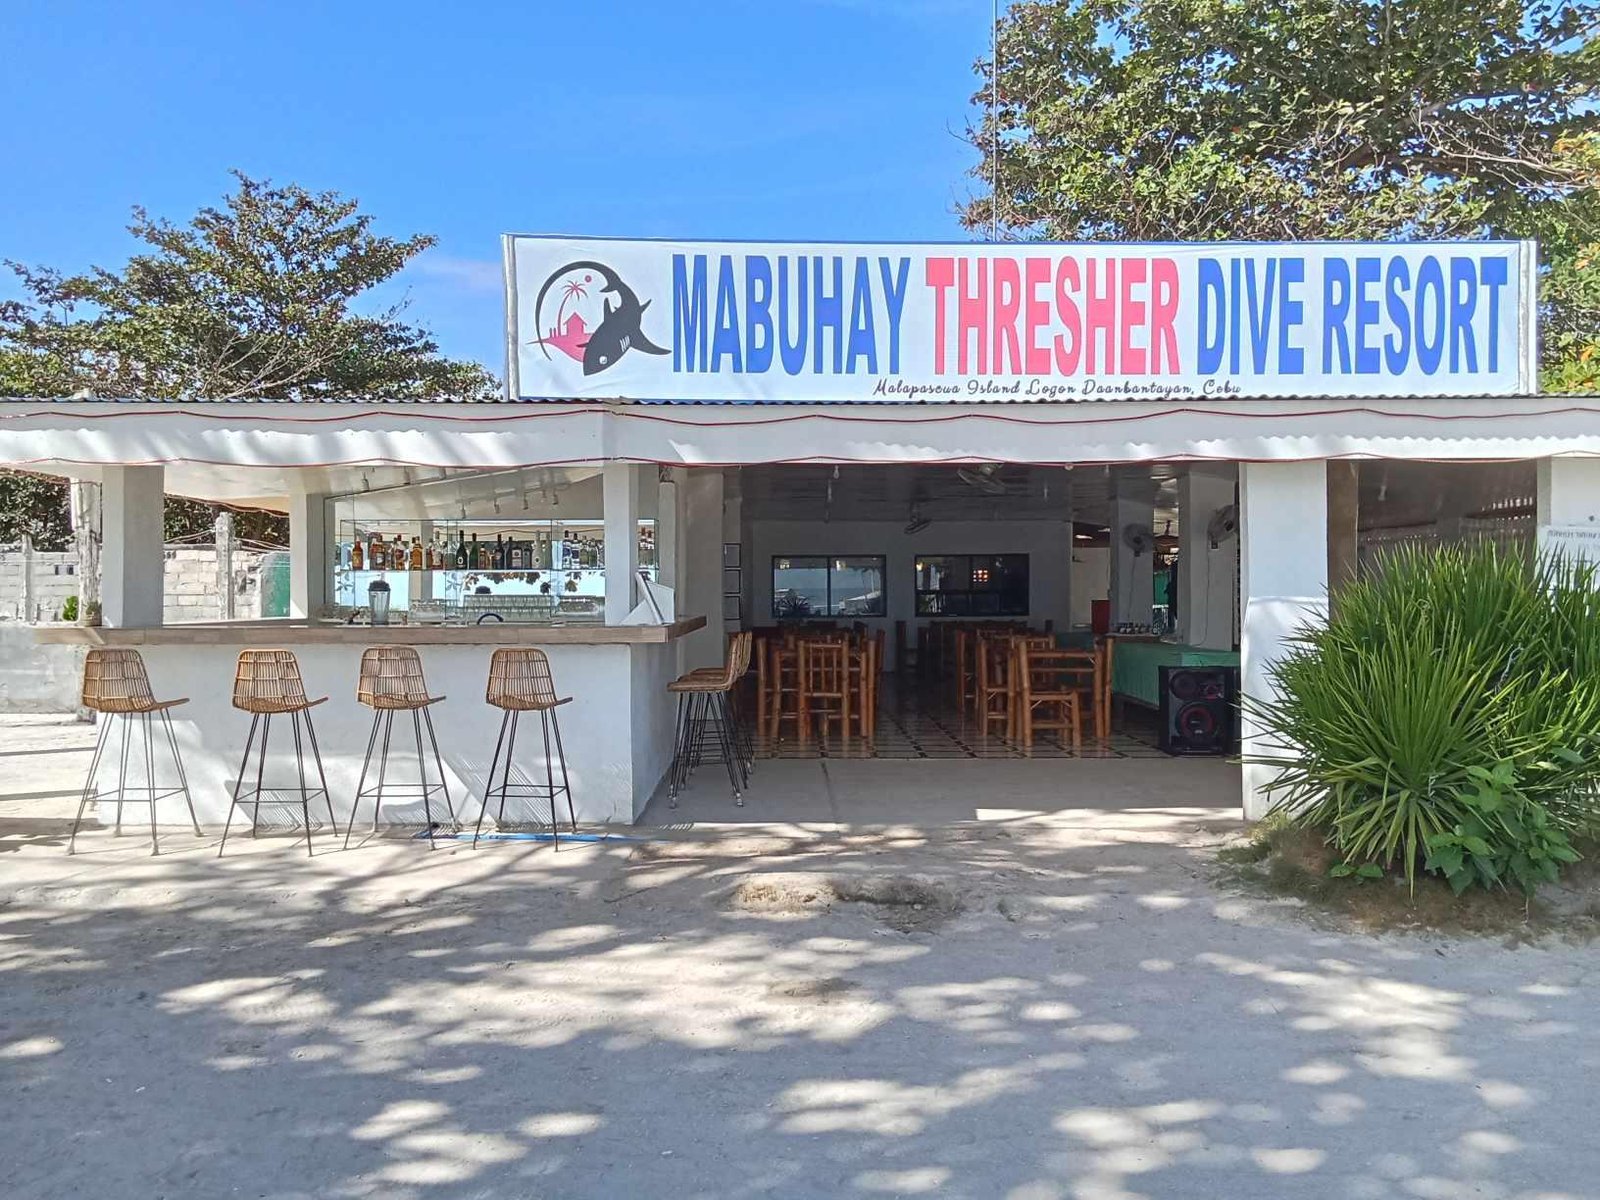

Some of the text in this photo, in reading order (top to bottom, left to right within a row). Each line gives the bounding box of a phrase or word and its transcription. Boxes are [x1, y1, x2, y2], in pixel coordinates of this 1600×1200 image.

[672, 253, 1508, 377] MABUHAY THRESHER DIVE RESORT
[873, 378, 960, 399] Malapascua
[967, 379, 1020, 395] Island
[1025, 378, 1076, 398] Logon
[1202, 379, 1242, 395] Cebu
